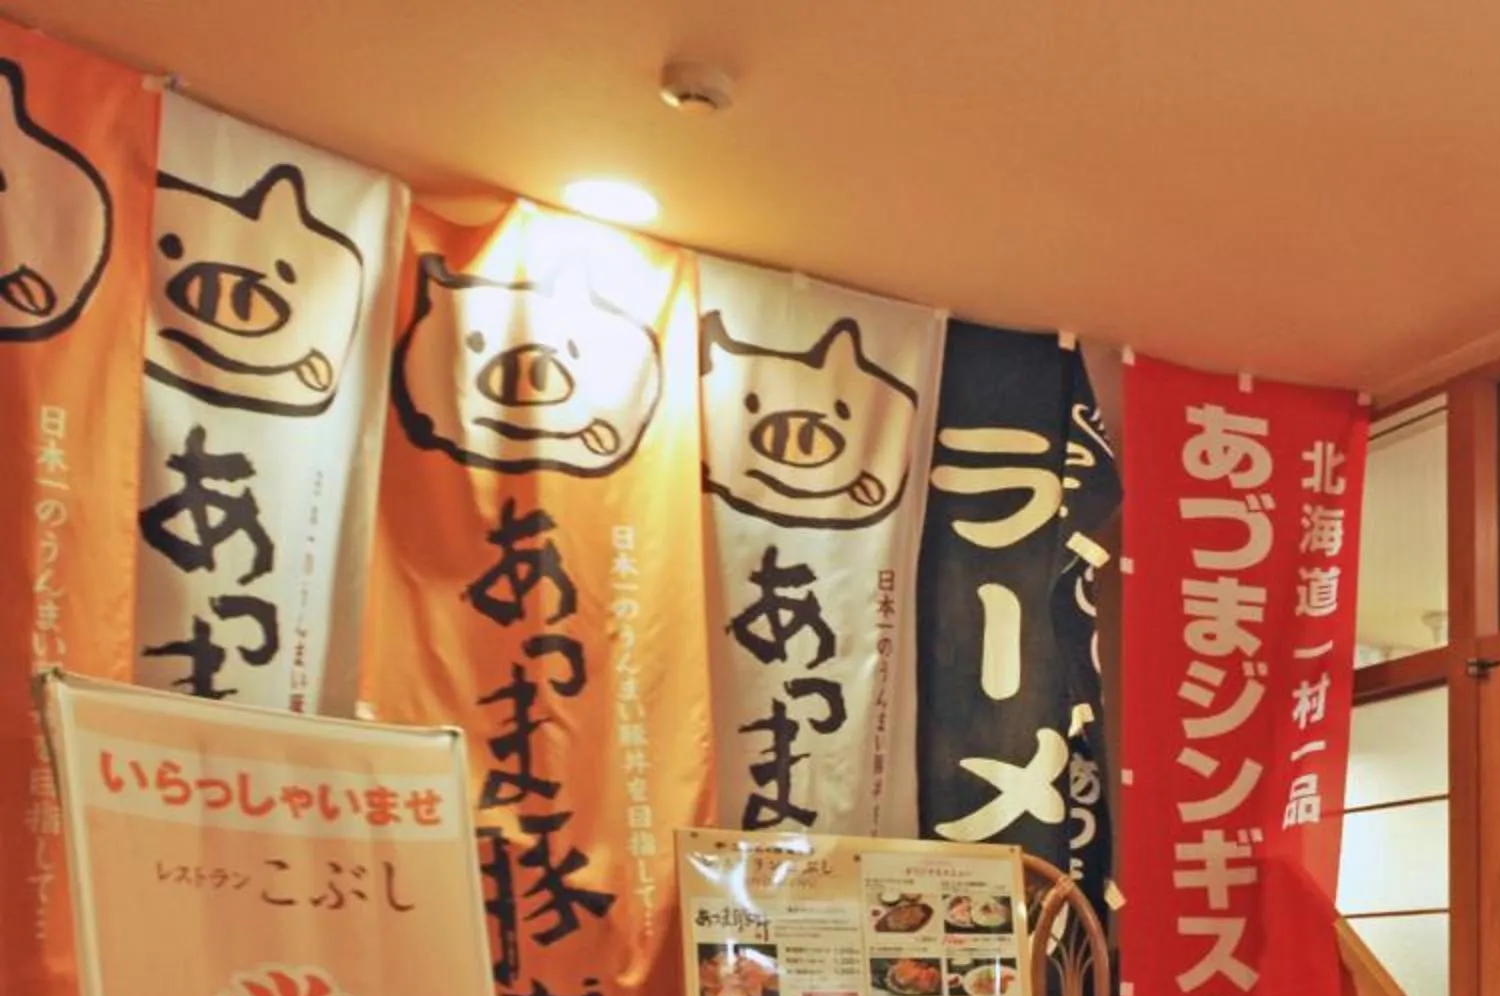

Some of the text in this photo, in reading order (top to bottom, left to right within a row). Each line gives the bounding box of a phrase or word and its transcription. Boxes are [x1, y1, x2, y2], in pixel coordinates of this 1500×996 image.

[725, 544, 849, 832] あつま
[929, 427, 1071, 843] ラーメ
[1281, 440, 1347, 831] 北海道一村一品
[101, 749, 443, 827] いらっしゃいませ
[156, 858, 415, 912] レストラン こぶし
